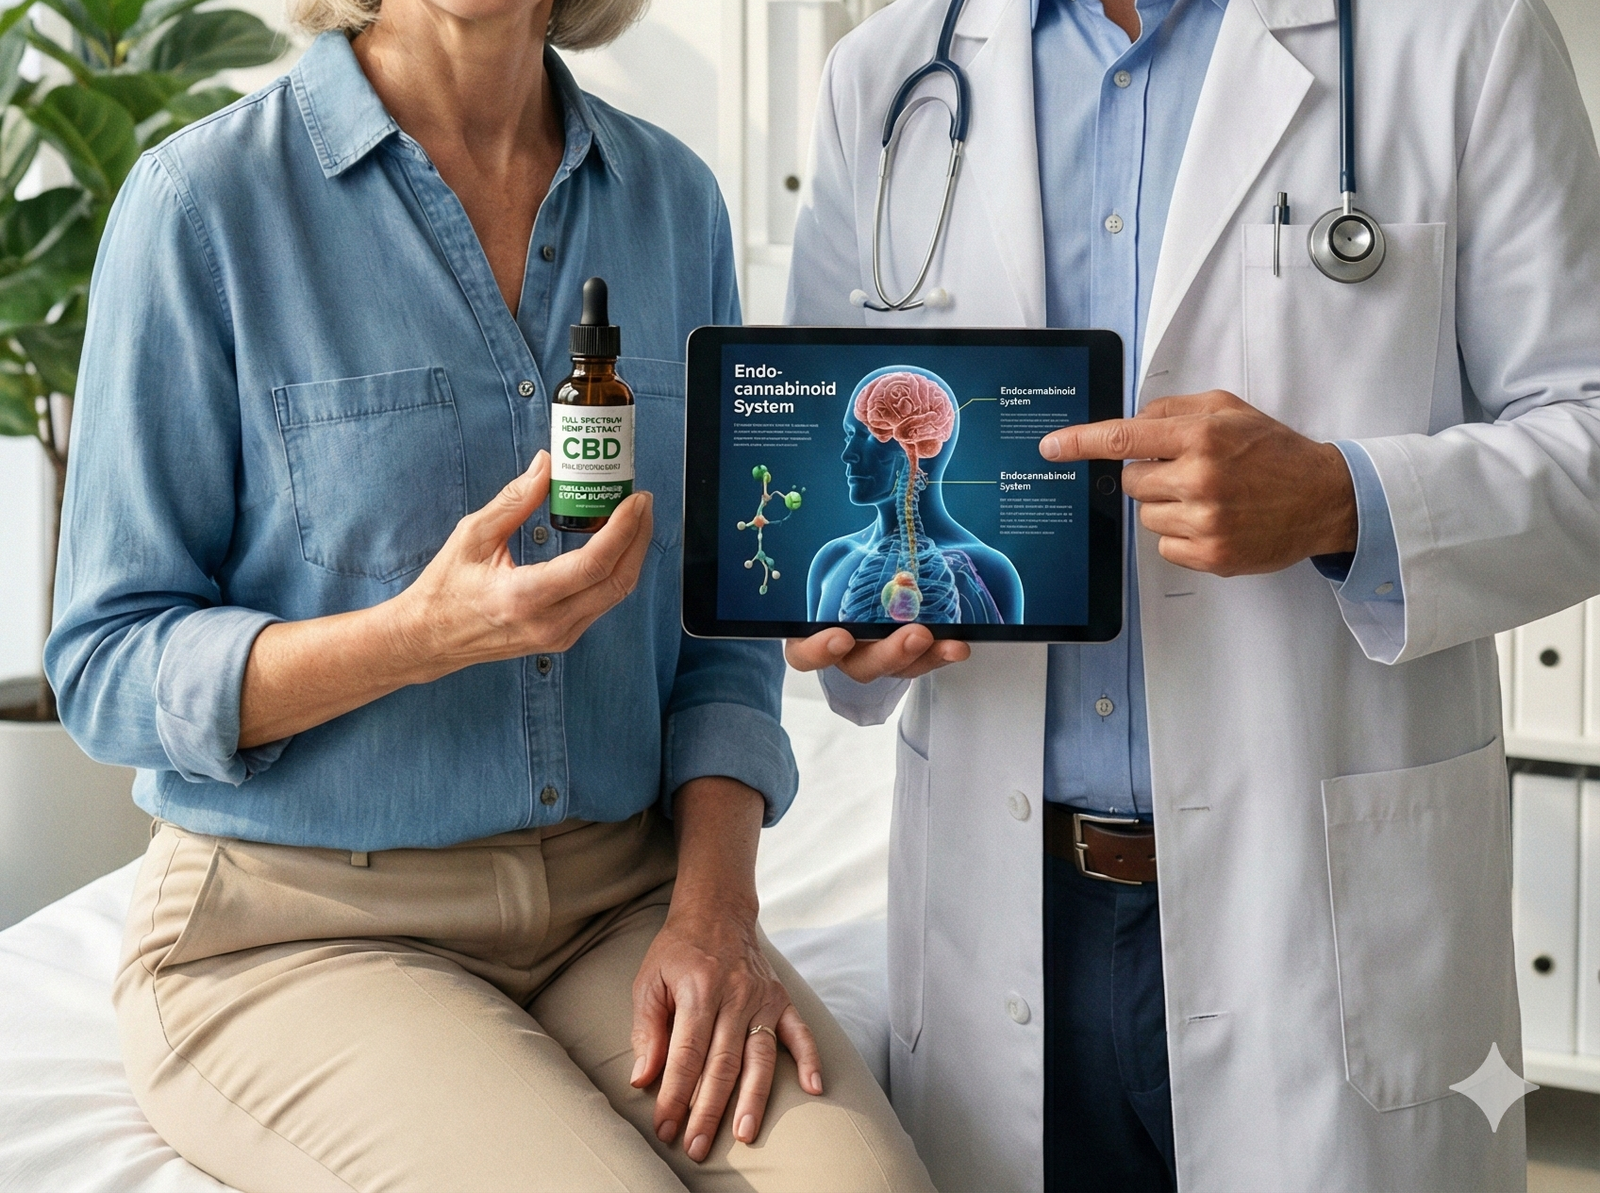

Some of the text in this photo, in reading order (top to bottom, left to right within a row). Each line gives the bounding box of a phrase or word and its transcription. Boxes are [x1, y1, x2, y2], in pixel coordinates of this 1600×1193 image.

[734, 363, 783, 379] Endo-
[734, 380, 837, 396] cannabinoid
[734, 399, 795, 417] System
[999, 397, 1031, 408] System
[563, 436, 621, 459] CBD
[999, 481, 1031, 493] System
